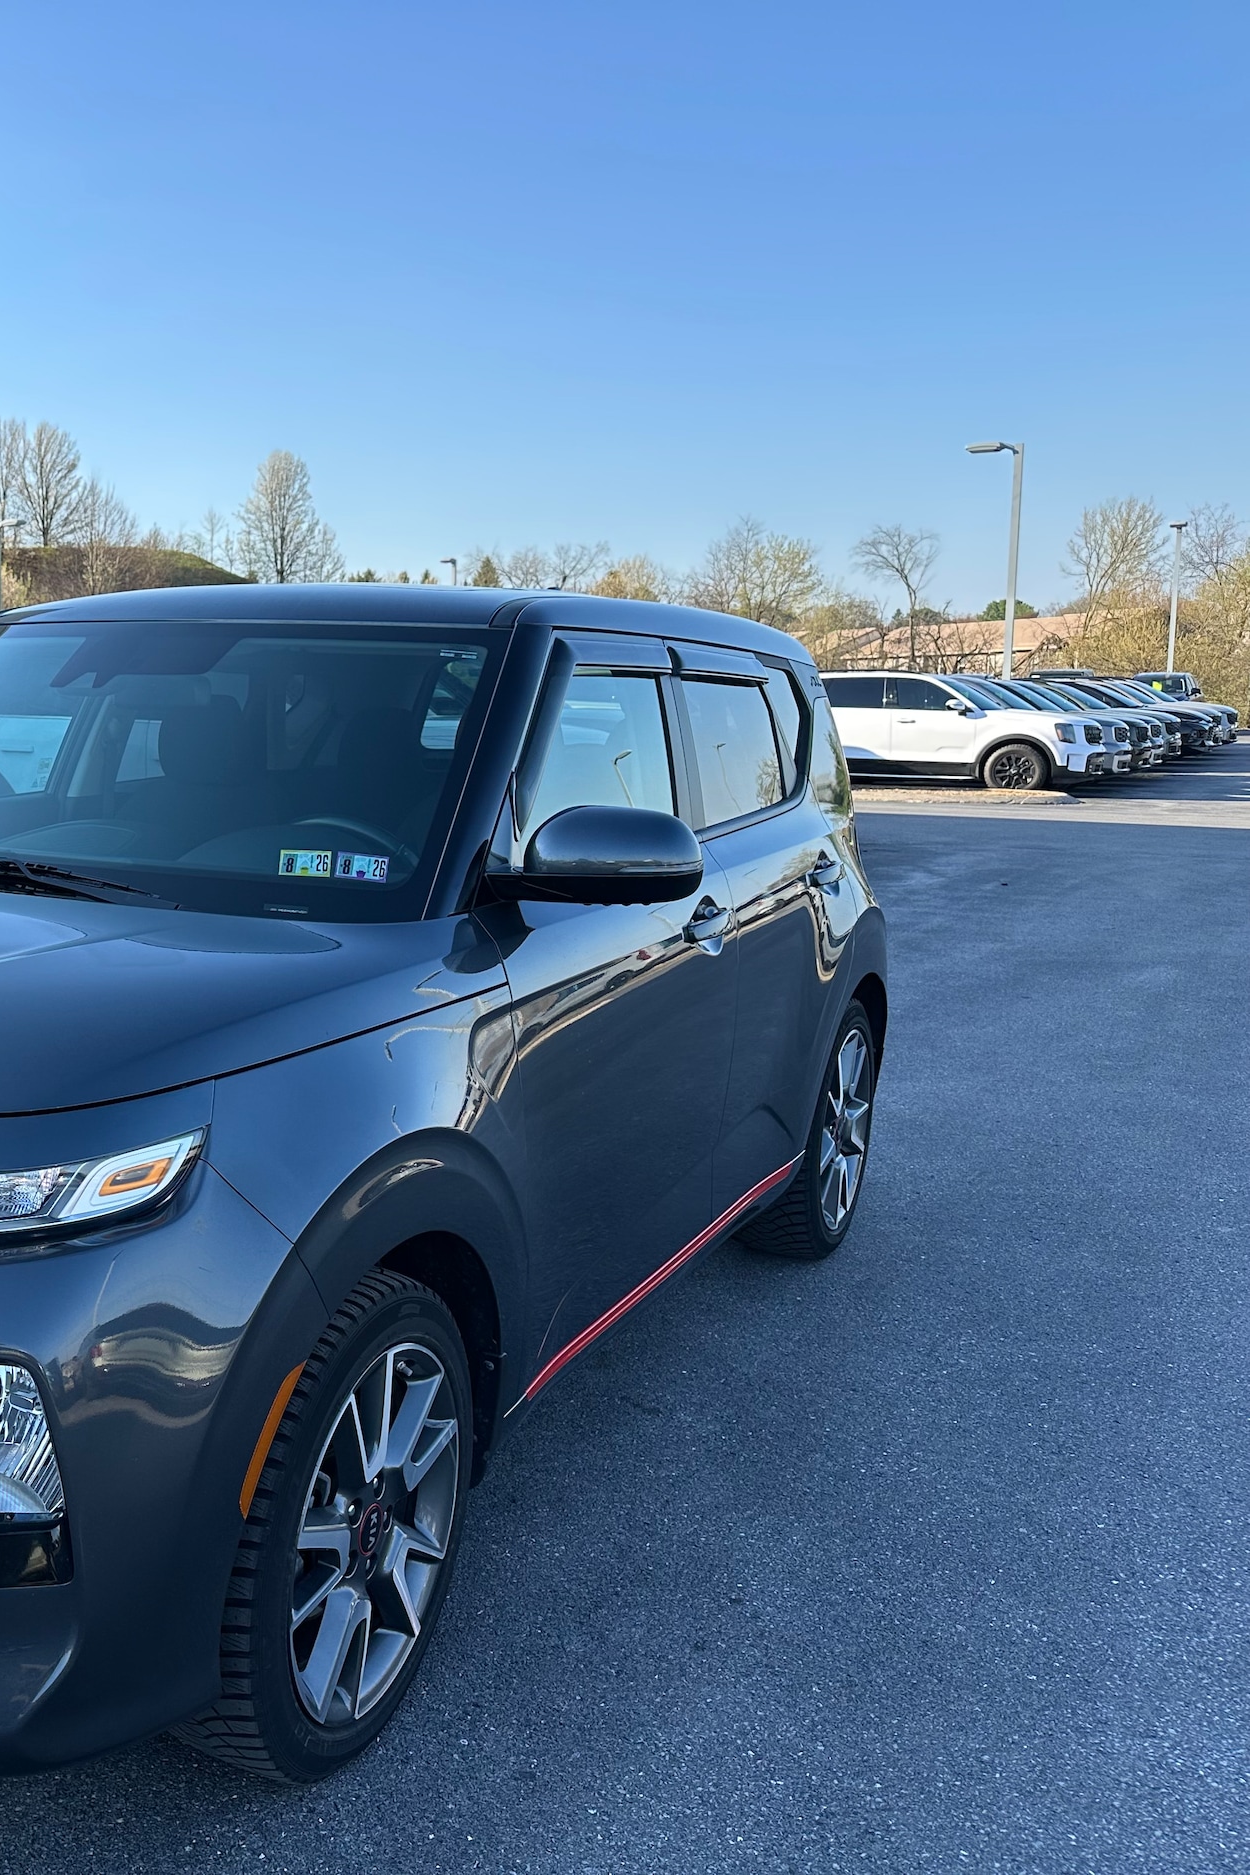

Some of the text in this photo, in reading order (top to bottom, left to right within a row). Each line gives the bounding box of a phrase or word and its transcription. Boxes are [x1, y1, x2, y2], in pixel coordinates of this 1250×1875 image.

[285, 857, 295, 873] 8
[316, 854, 329, 872] 26
[342, 859, 351, 875] 8
[372, 859, 387, 877] 26
[367, 1511, 378, 1550] KIA
